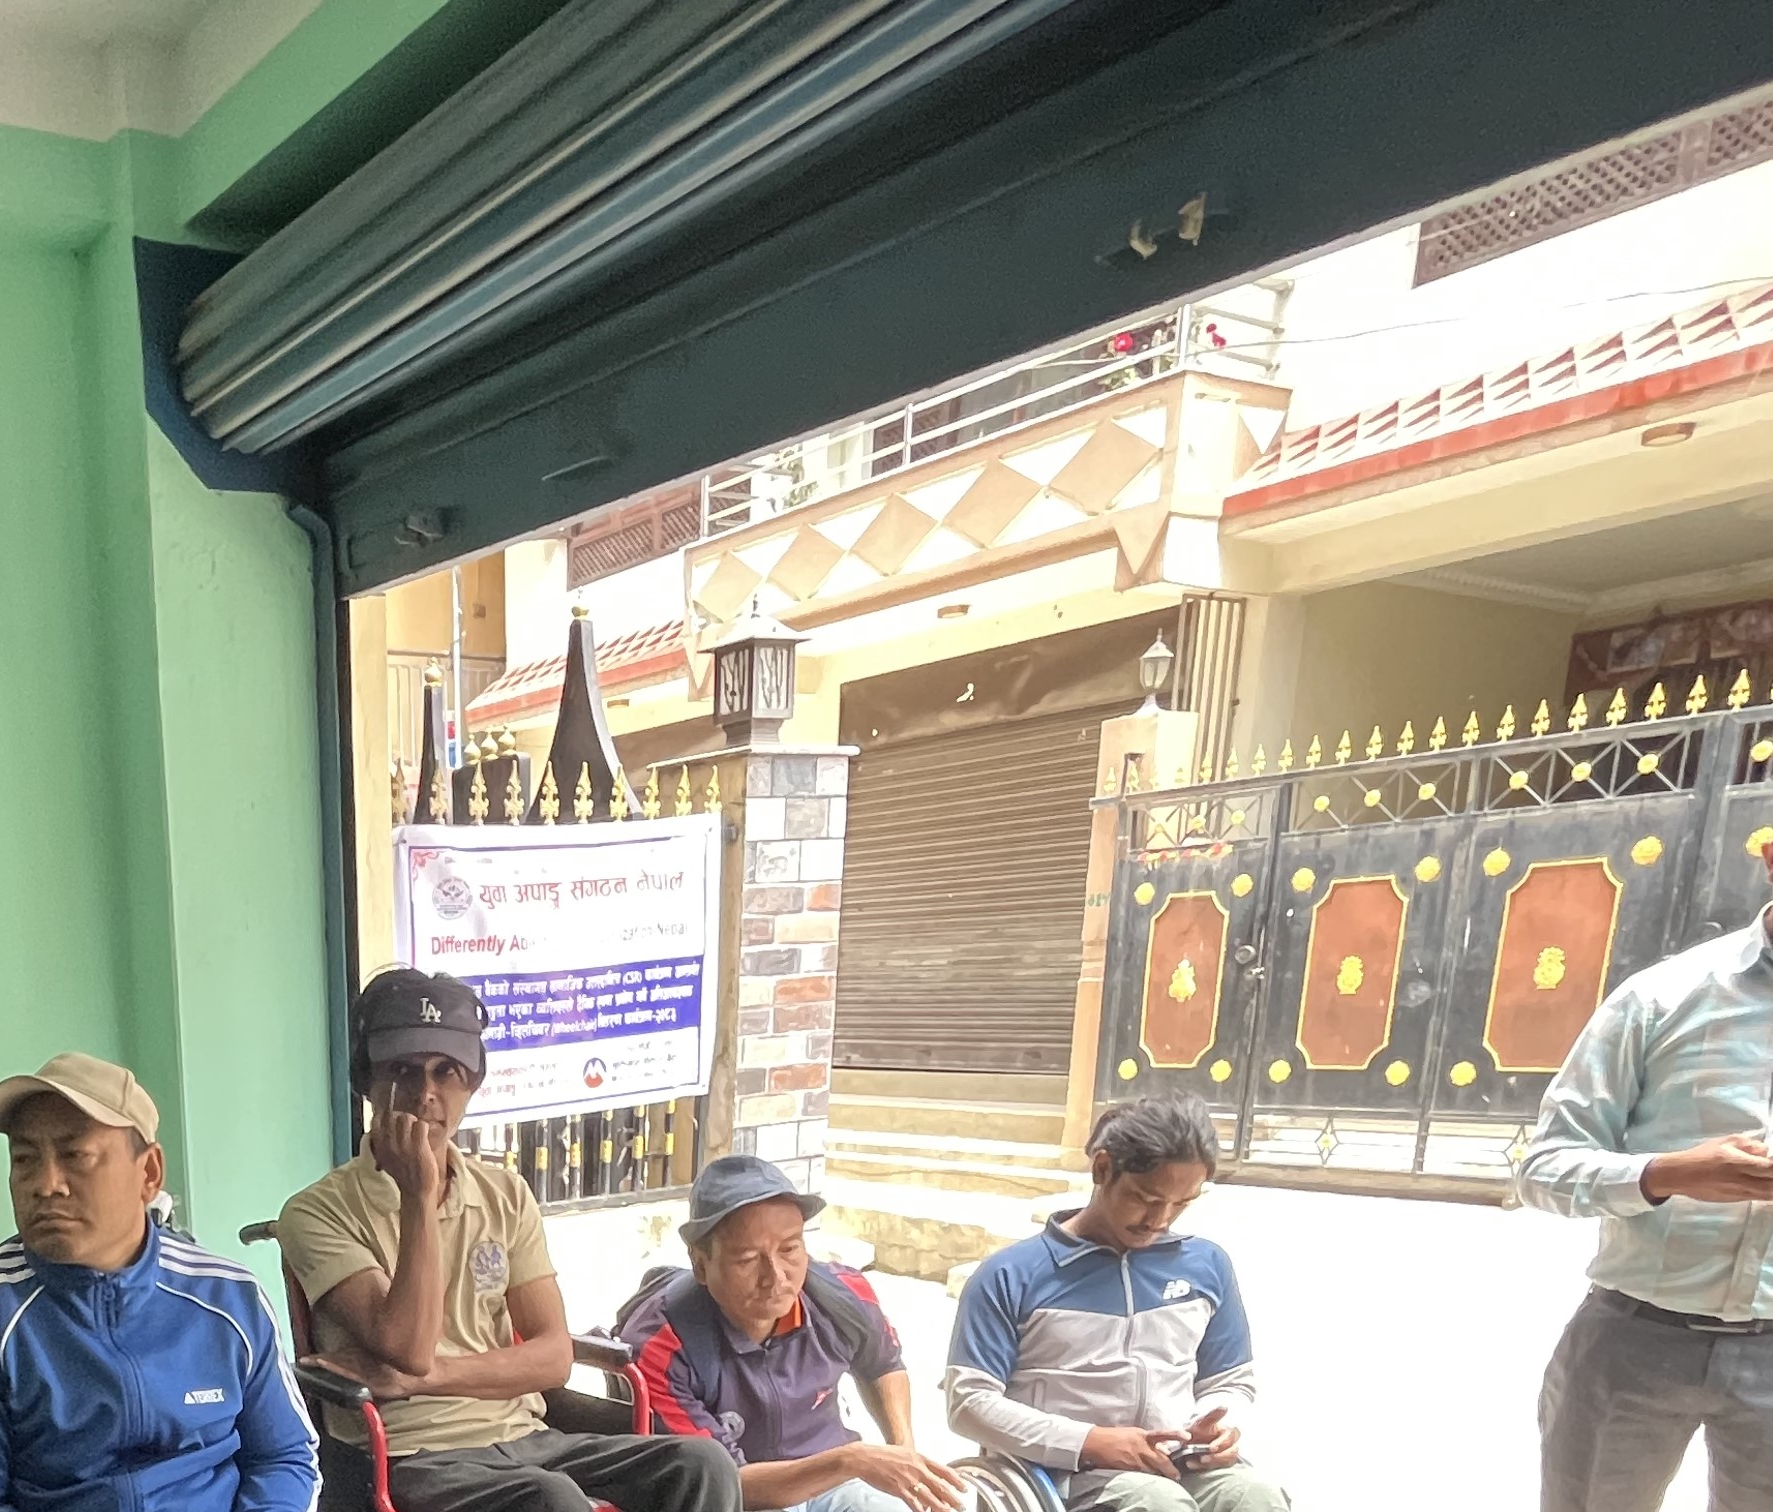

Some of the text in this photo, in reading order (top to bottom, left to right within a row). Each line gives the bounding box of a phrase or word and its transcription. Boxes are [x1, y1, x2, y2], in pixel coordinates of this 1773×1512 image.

[479, 884, 507, 910] युवा
[431, 934, 506, 957] Differently
[420, 997, 442, 1023] LA
